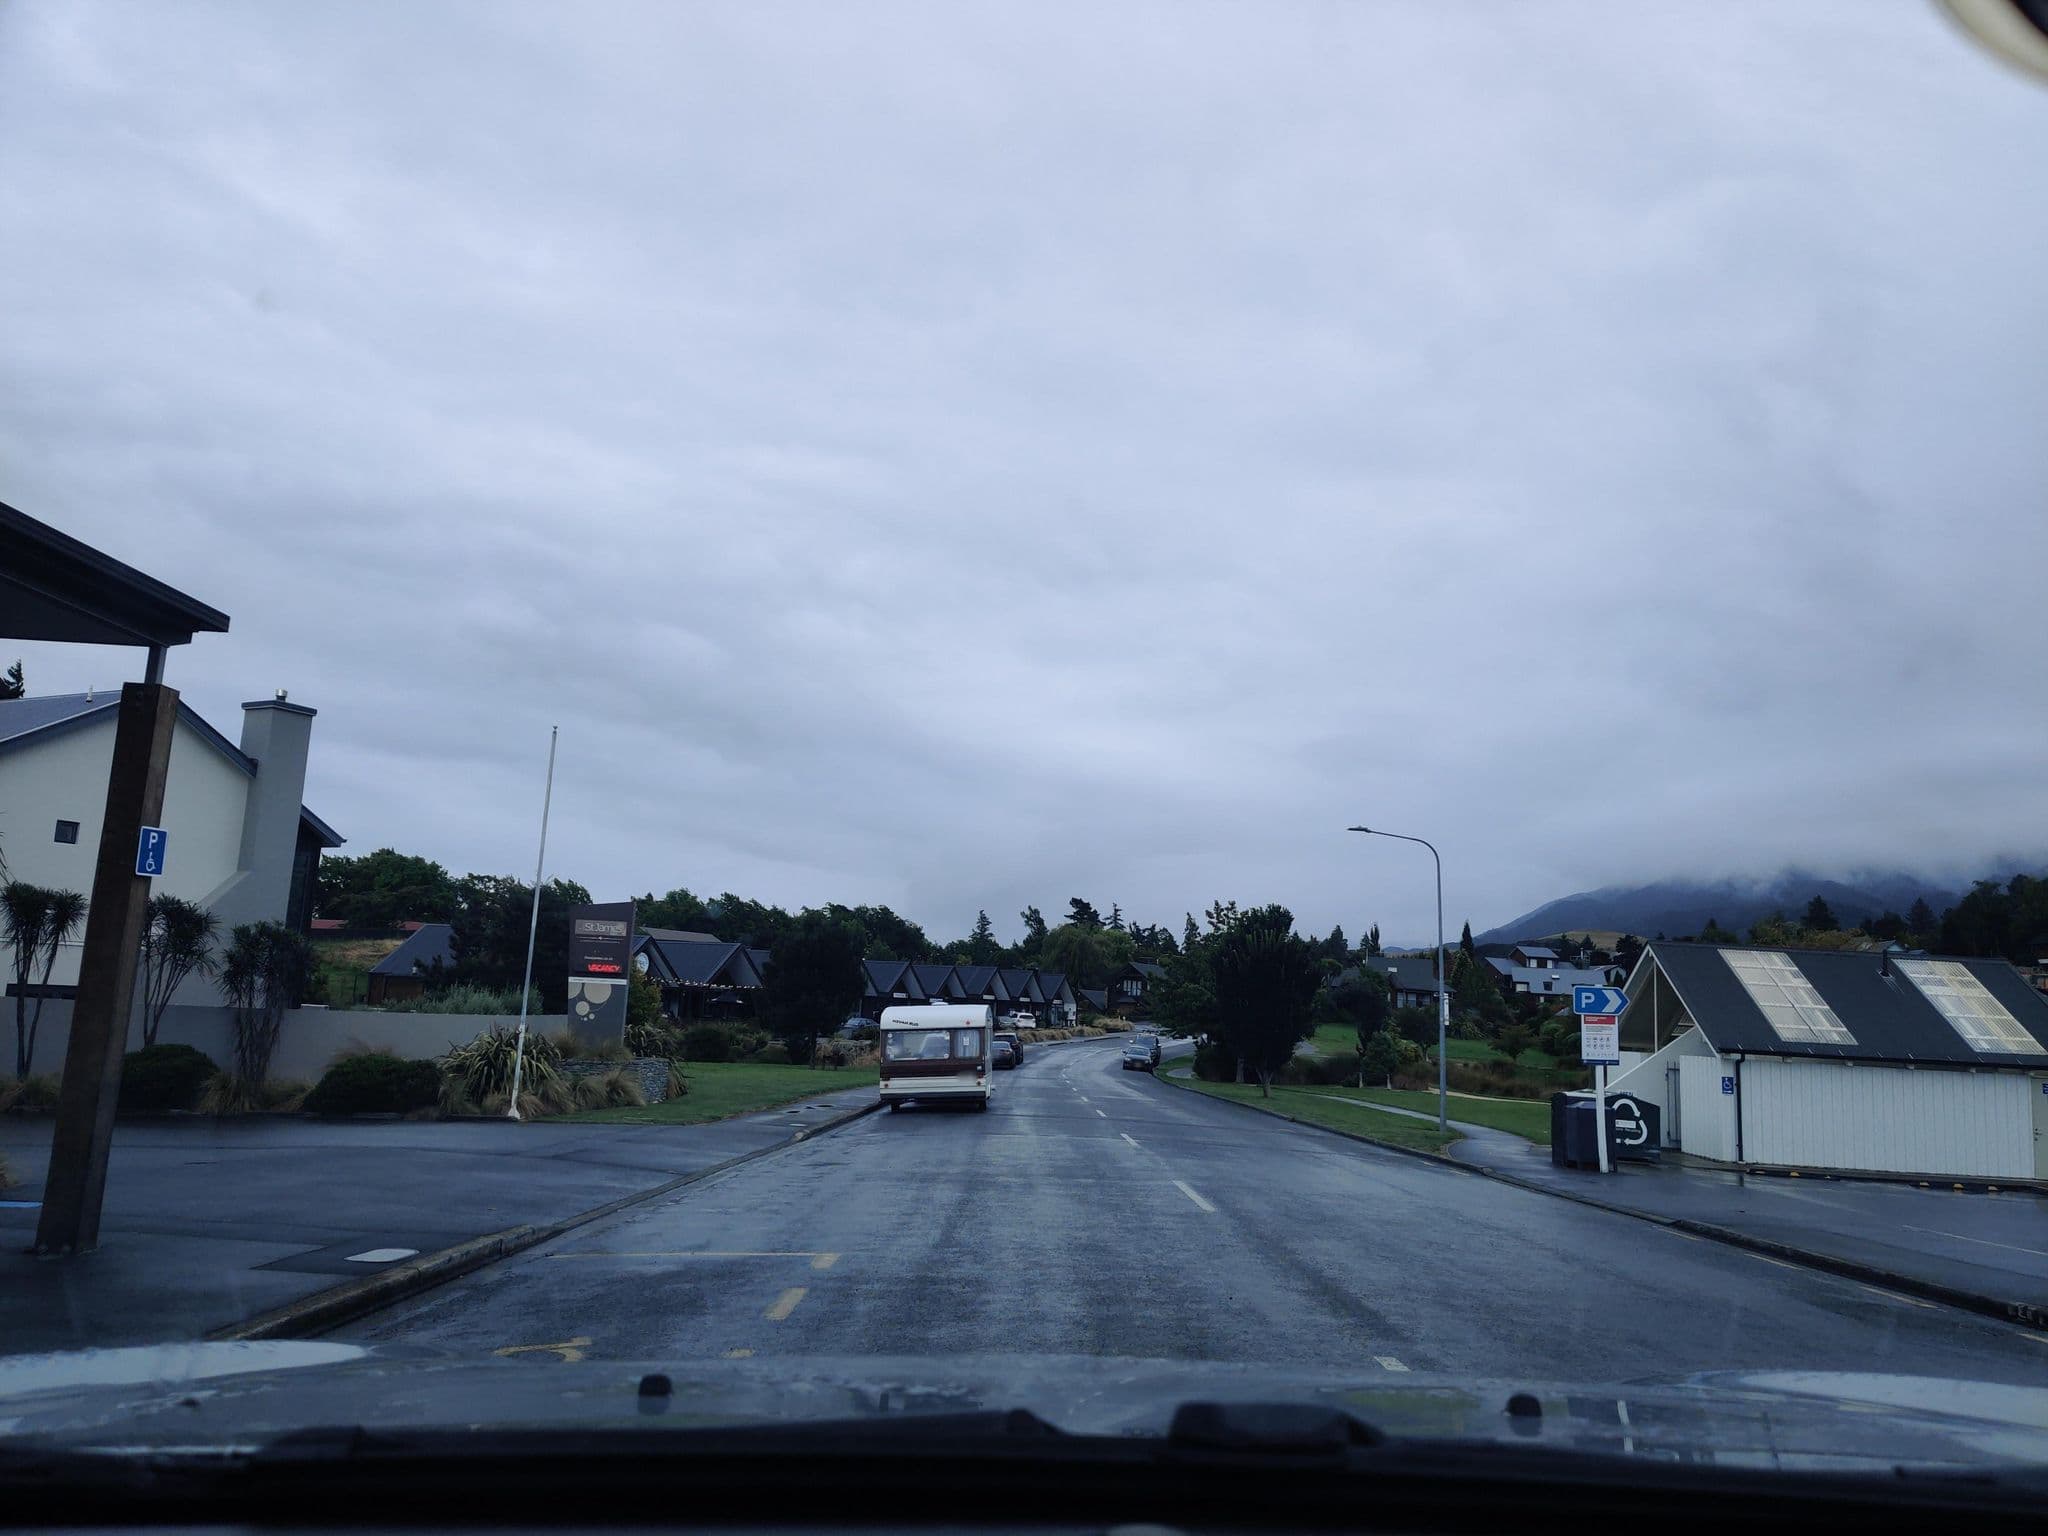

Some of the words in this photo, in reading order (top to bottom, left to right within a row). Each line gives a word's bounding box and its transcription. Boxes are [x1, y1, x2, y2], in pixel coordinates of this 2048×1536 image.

[148, 832, 158, 849] P
[588, 964, 621, 973] VACANCY
[1581, 992, 1595, 1008] P
